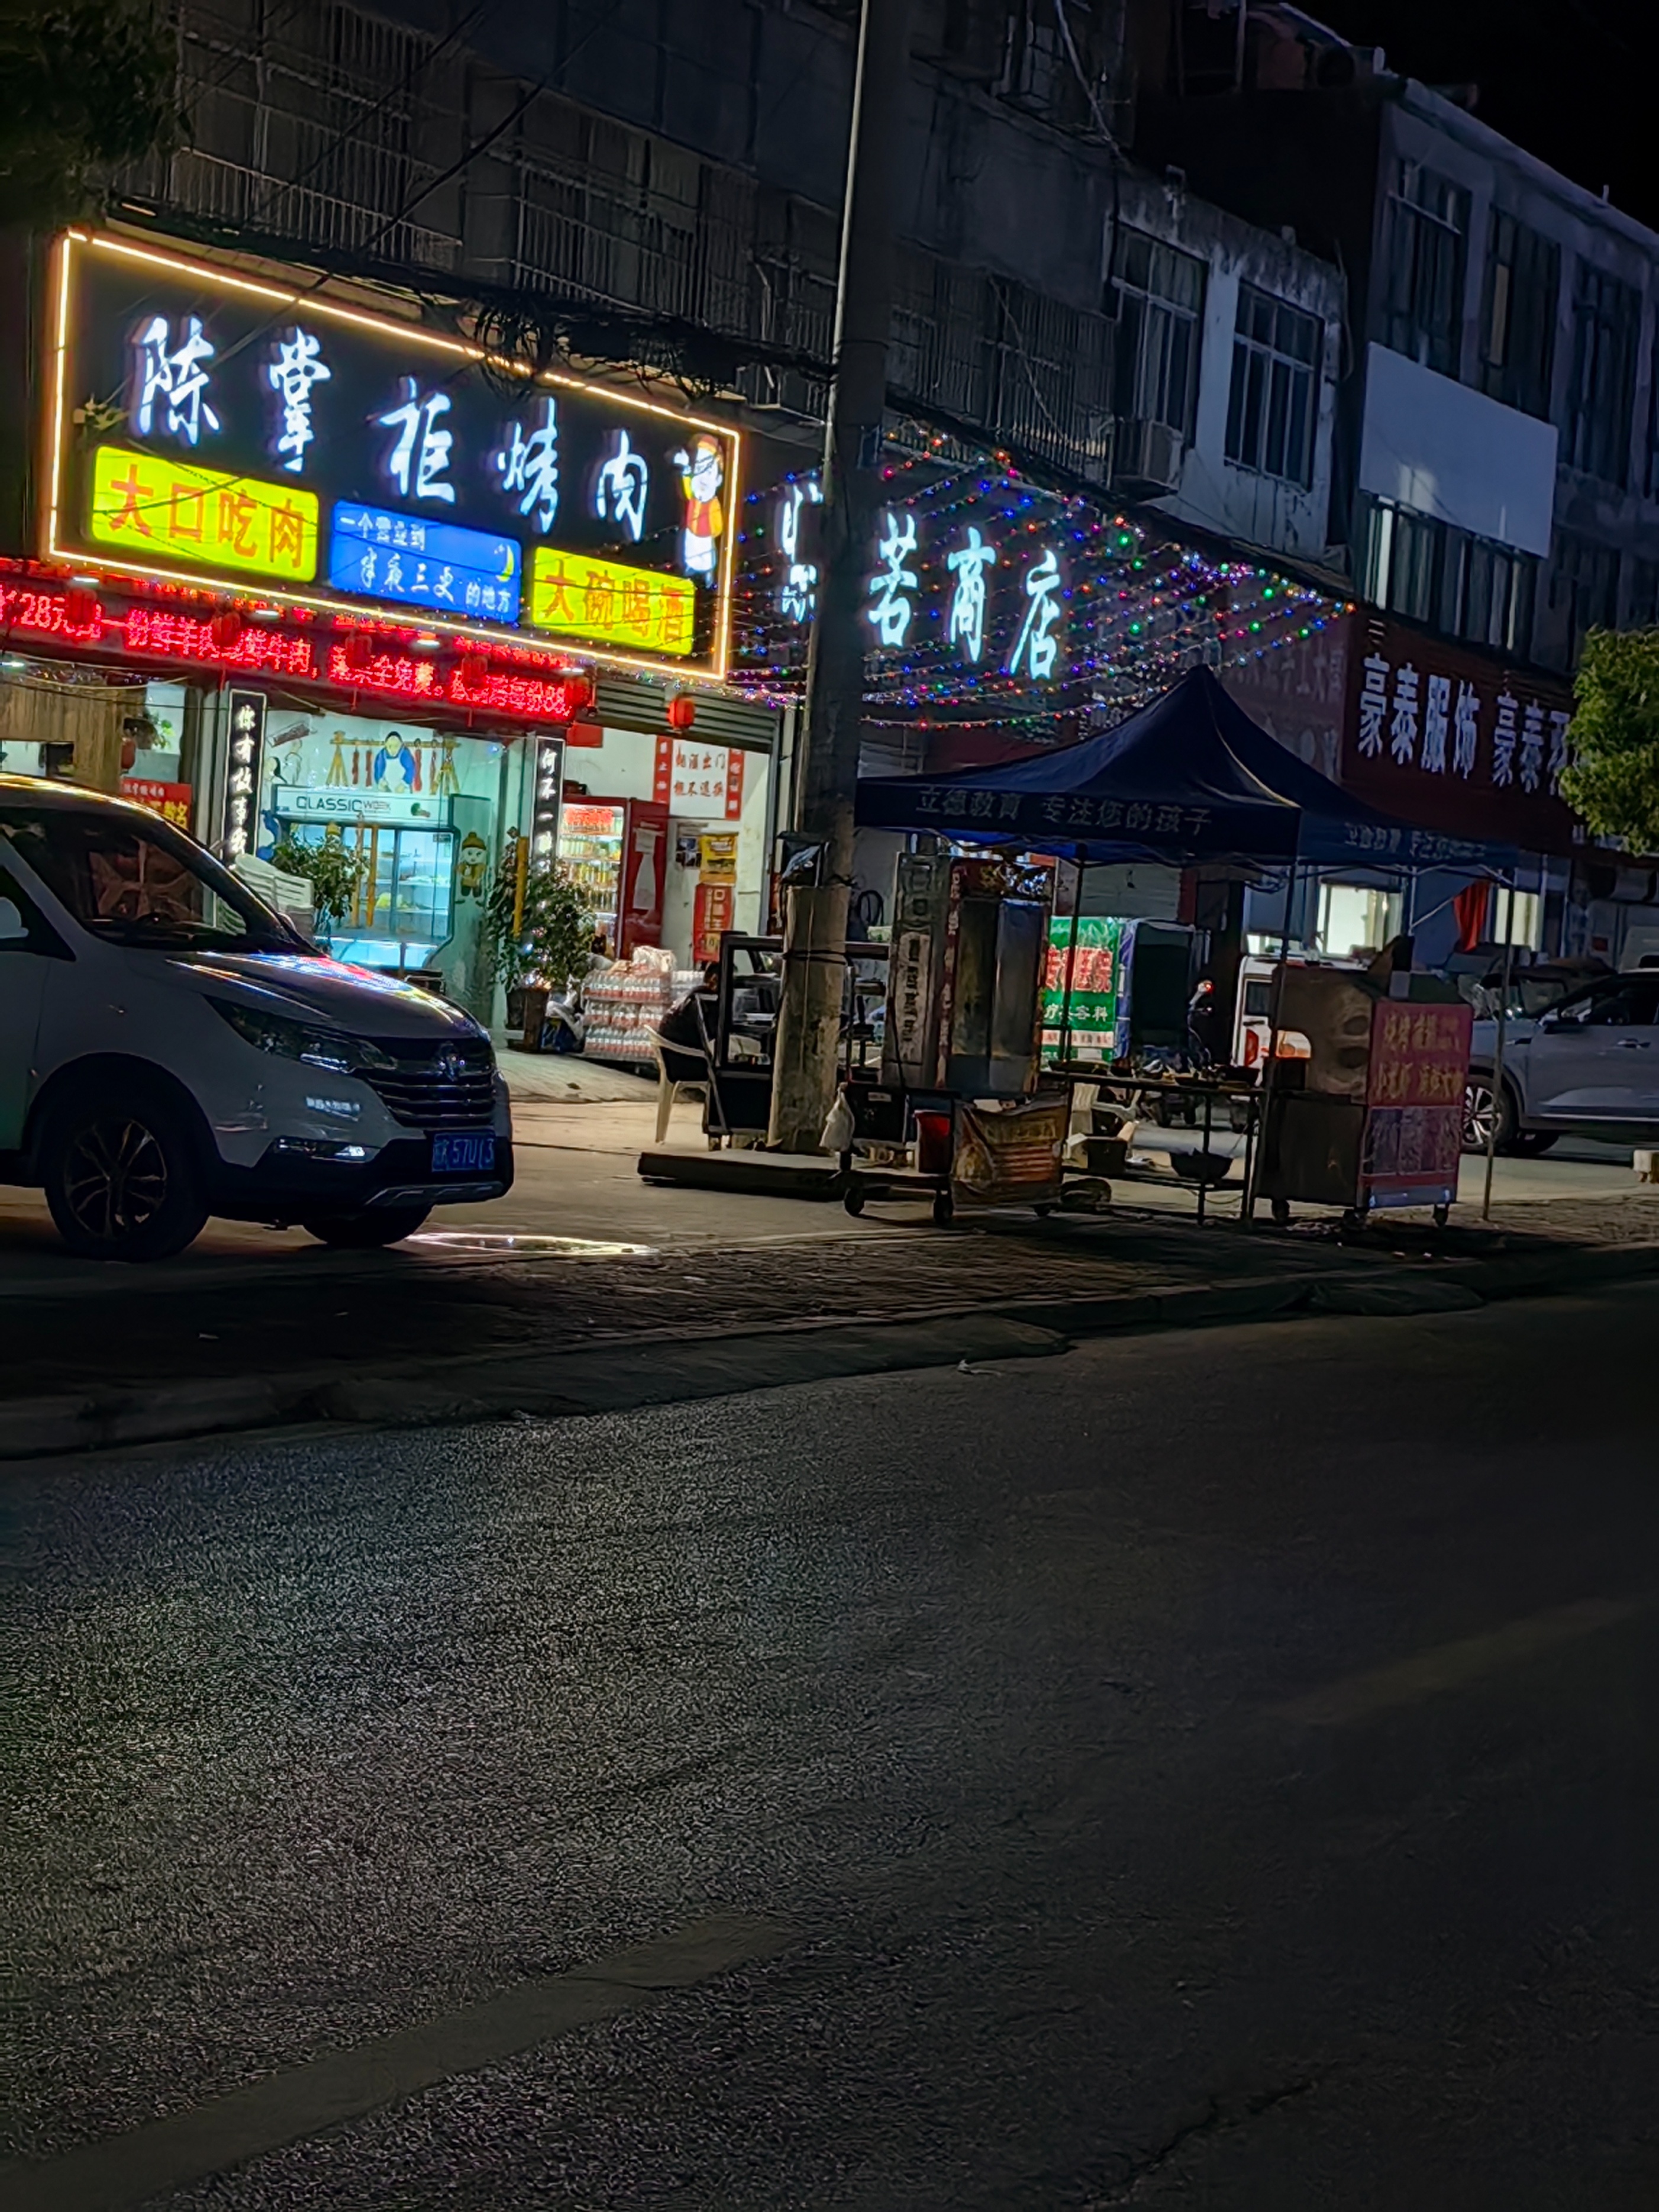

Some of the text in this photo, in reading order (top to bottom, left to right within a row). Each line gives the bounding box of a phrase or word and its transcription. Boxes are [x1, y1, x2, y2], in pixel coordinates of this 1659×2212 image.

[136, 315, 648, 542] 陈掌柜烤肉
[109, 464, 304, 568] 大口吃肉
[543, 559, 684, 643] 大碗喝酒
[296, 796, 363, 812] CLASSIC
